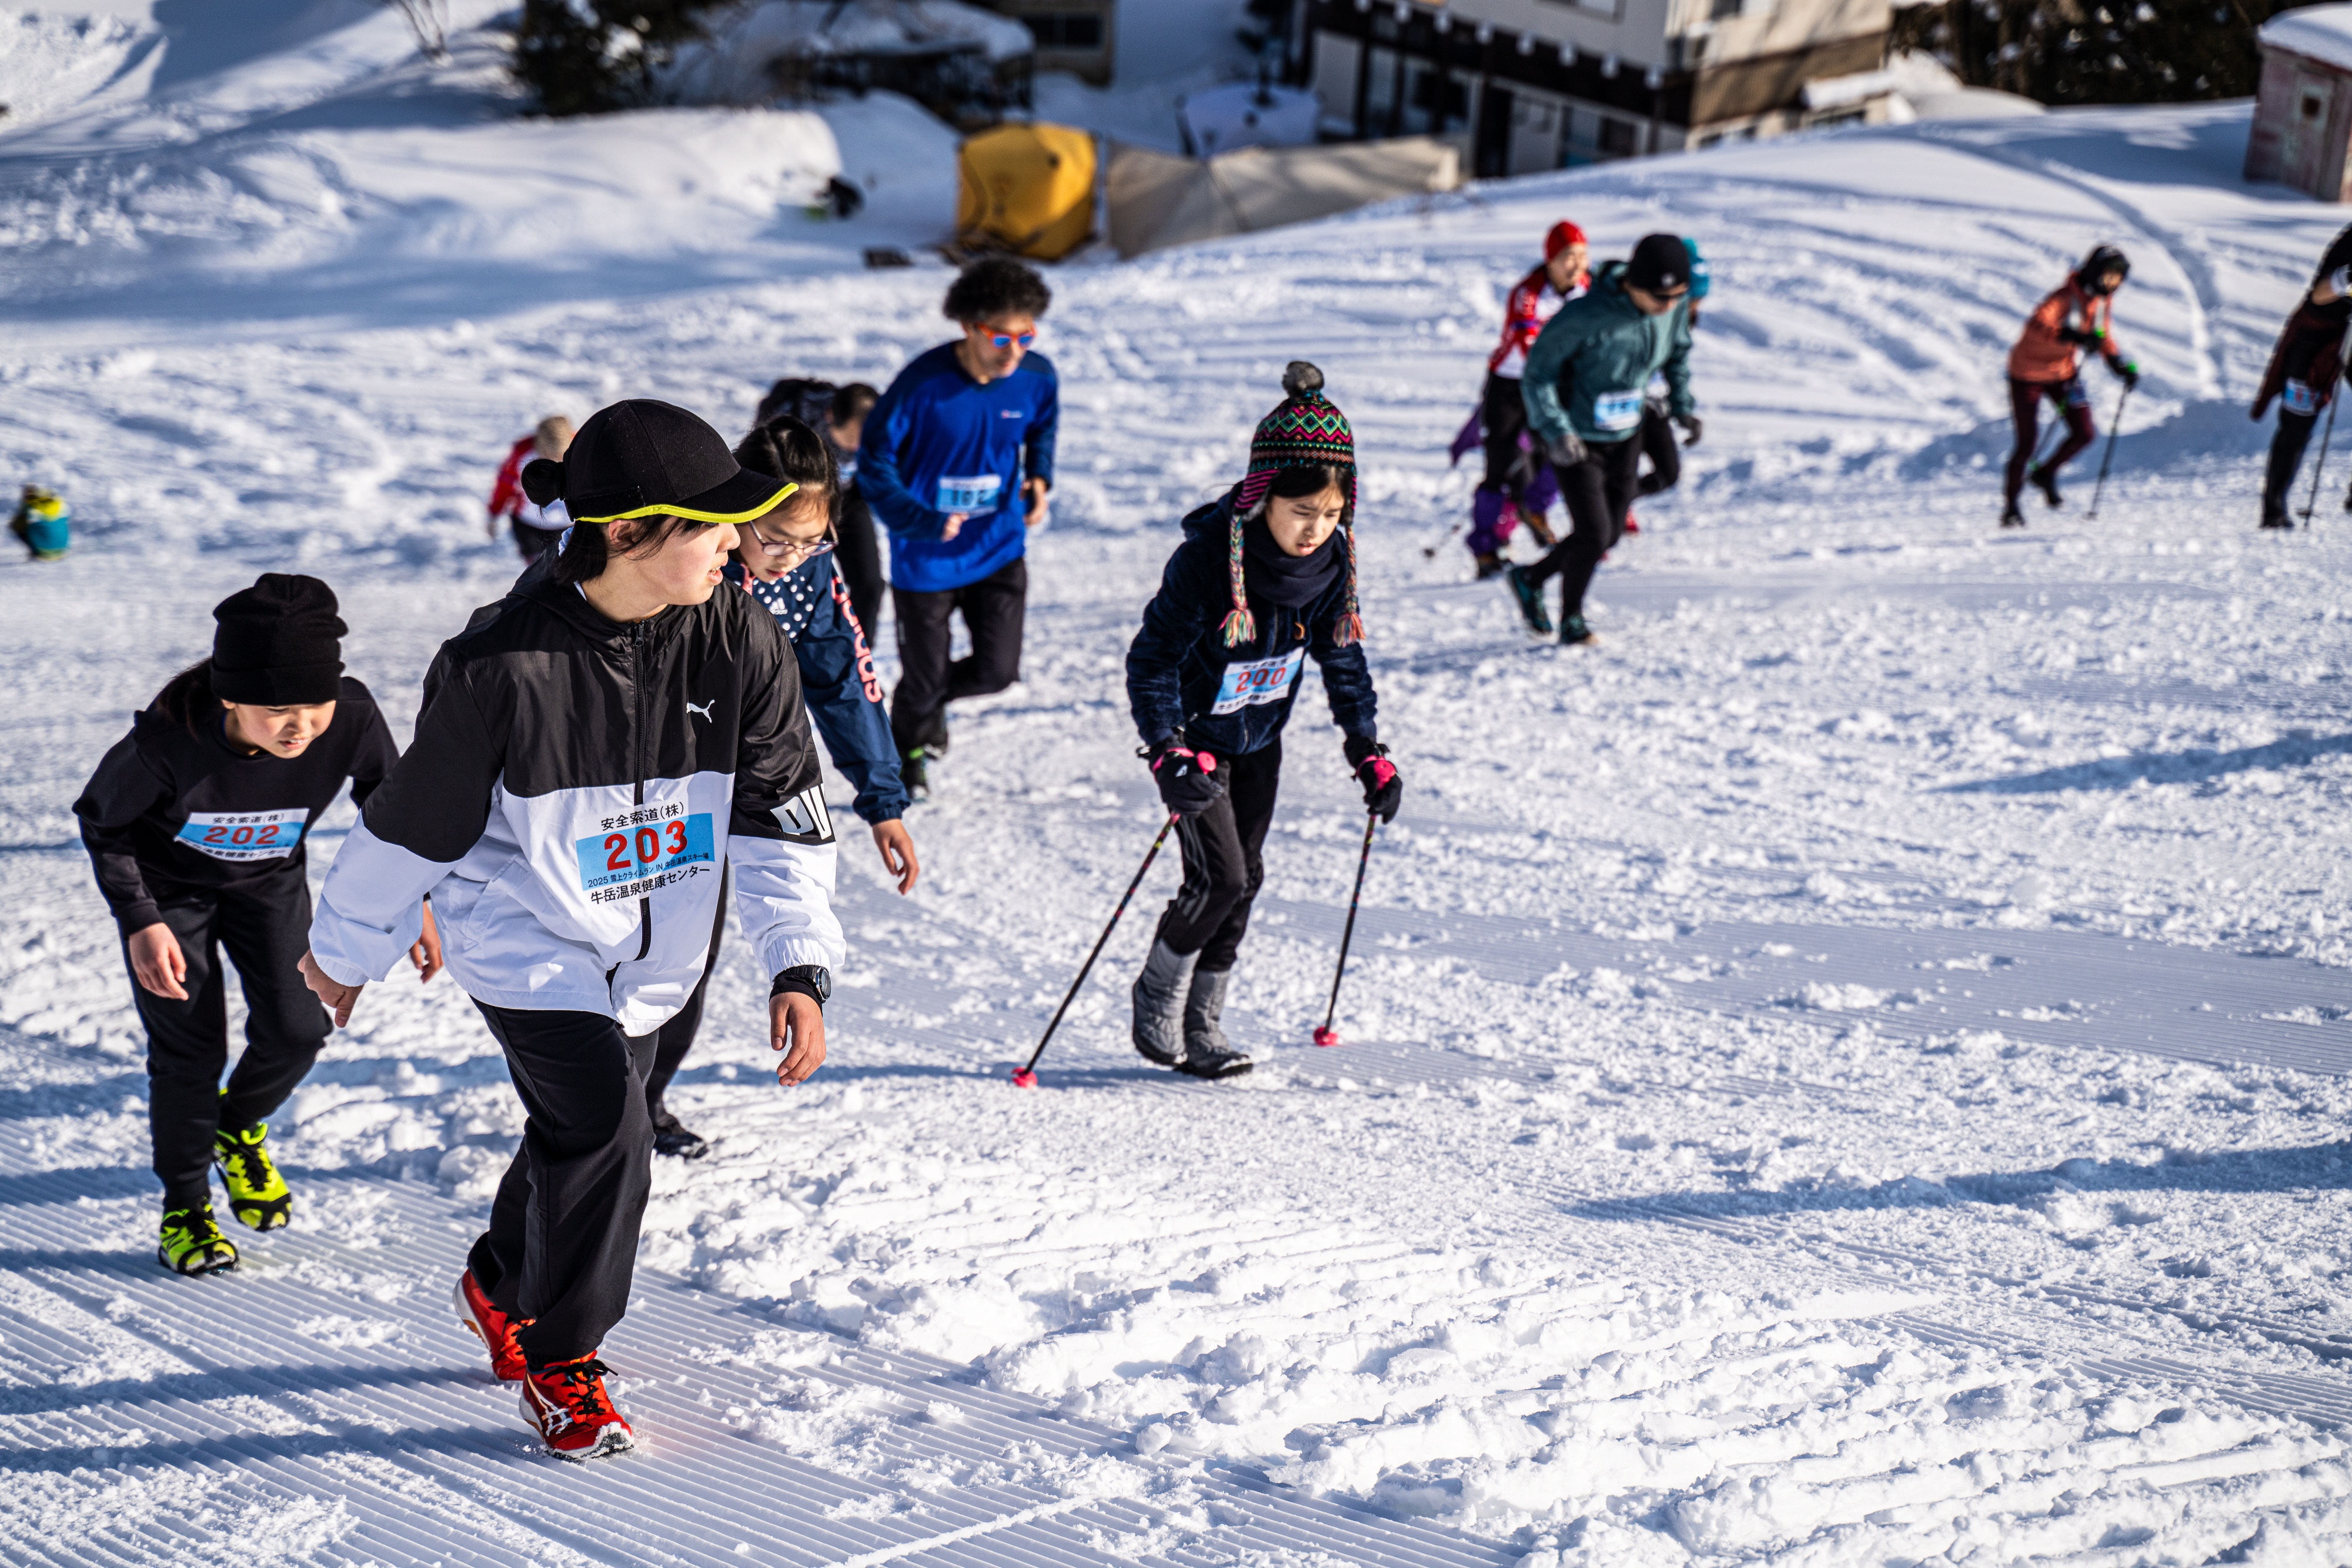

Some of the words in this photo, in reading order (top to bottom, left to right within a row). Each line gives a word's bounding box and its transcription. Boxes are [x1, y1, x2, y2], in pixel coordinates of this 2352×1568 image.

[1235, 667, 1287, 694] 200
[203, 824, 280, 845] 202
[604, 820, 687, 871] 203
[588, 877, 609, 888] 2025
[610, 867, 654, 882] 雪上クライムラン
[665, 852, 709, 868] 牛岳温泉スキー場
[590, 865, 710, 905] 牛岳温泉健康センター
